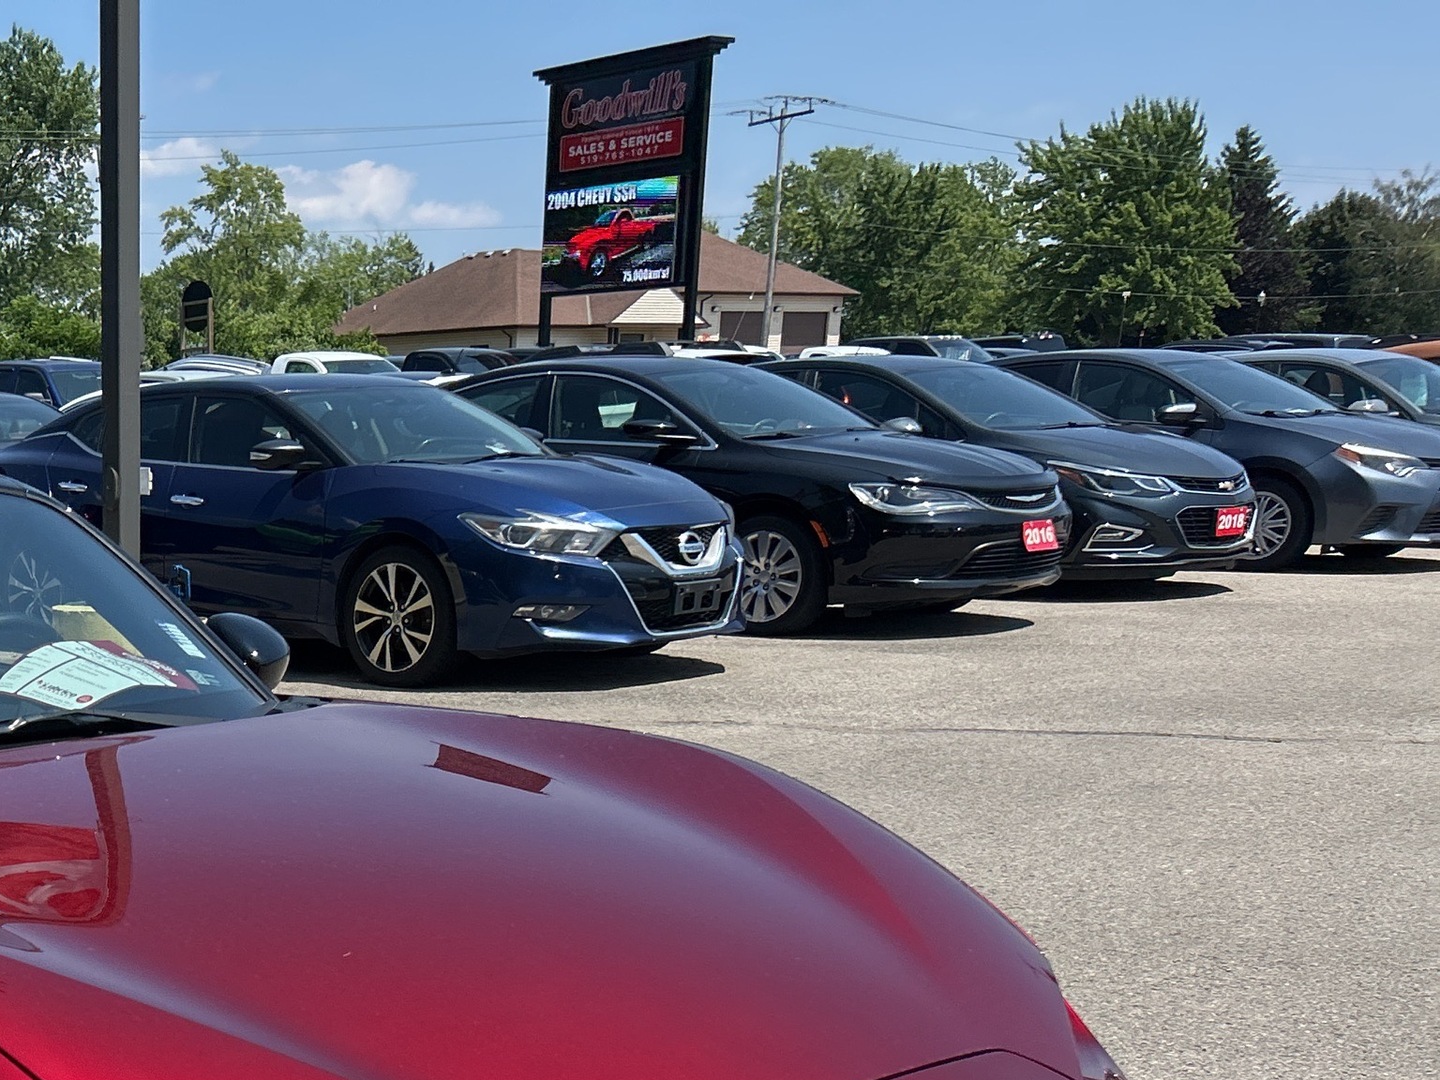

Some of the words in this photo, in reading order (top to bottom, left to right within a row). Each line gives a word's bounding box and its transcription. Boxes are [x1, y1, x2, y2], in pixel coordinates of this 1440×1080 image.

[561, 69, 687, 128] Goodwill's
[568, 141, 605, 157] SALES
[608, 139, 616, 151] &
[620, 130, 673, 149] SERVICE
[547, 191, 575, 211] 2004
[577, 186, 612, 208] CHEVY
[613, 185, 638, 203] SSR
[1217, 513, 1246, 530] 2018
[1024, 526, 1055, 545] 2016
